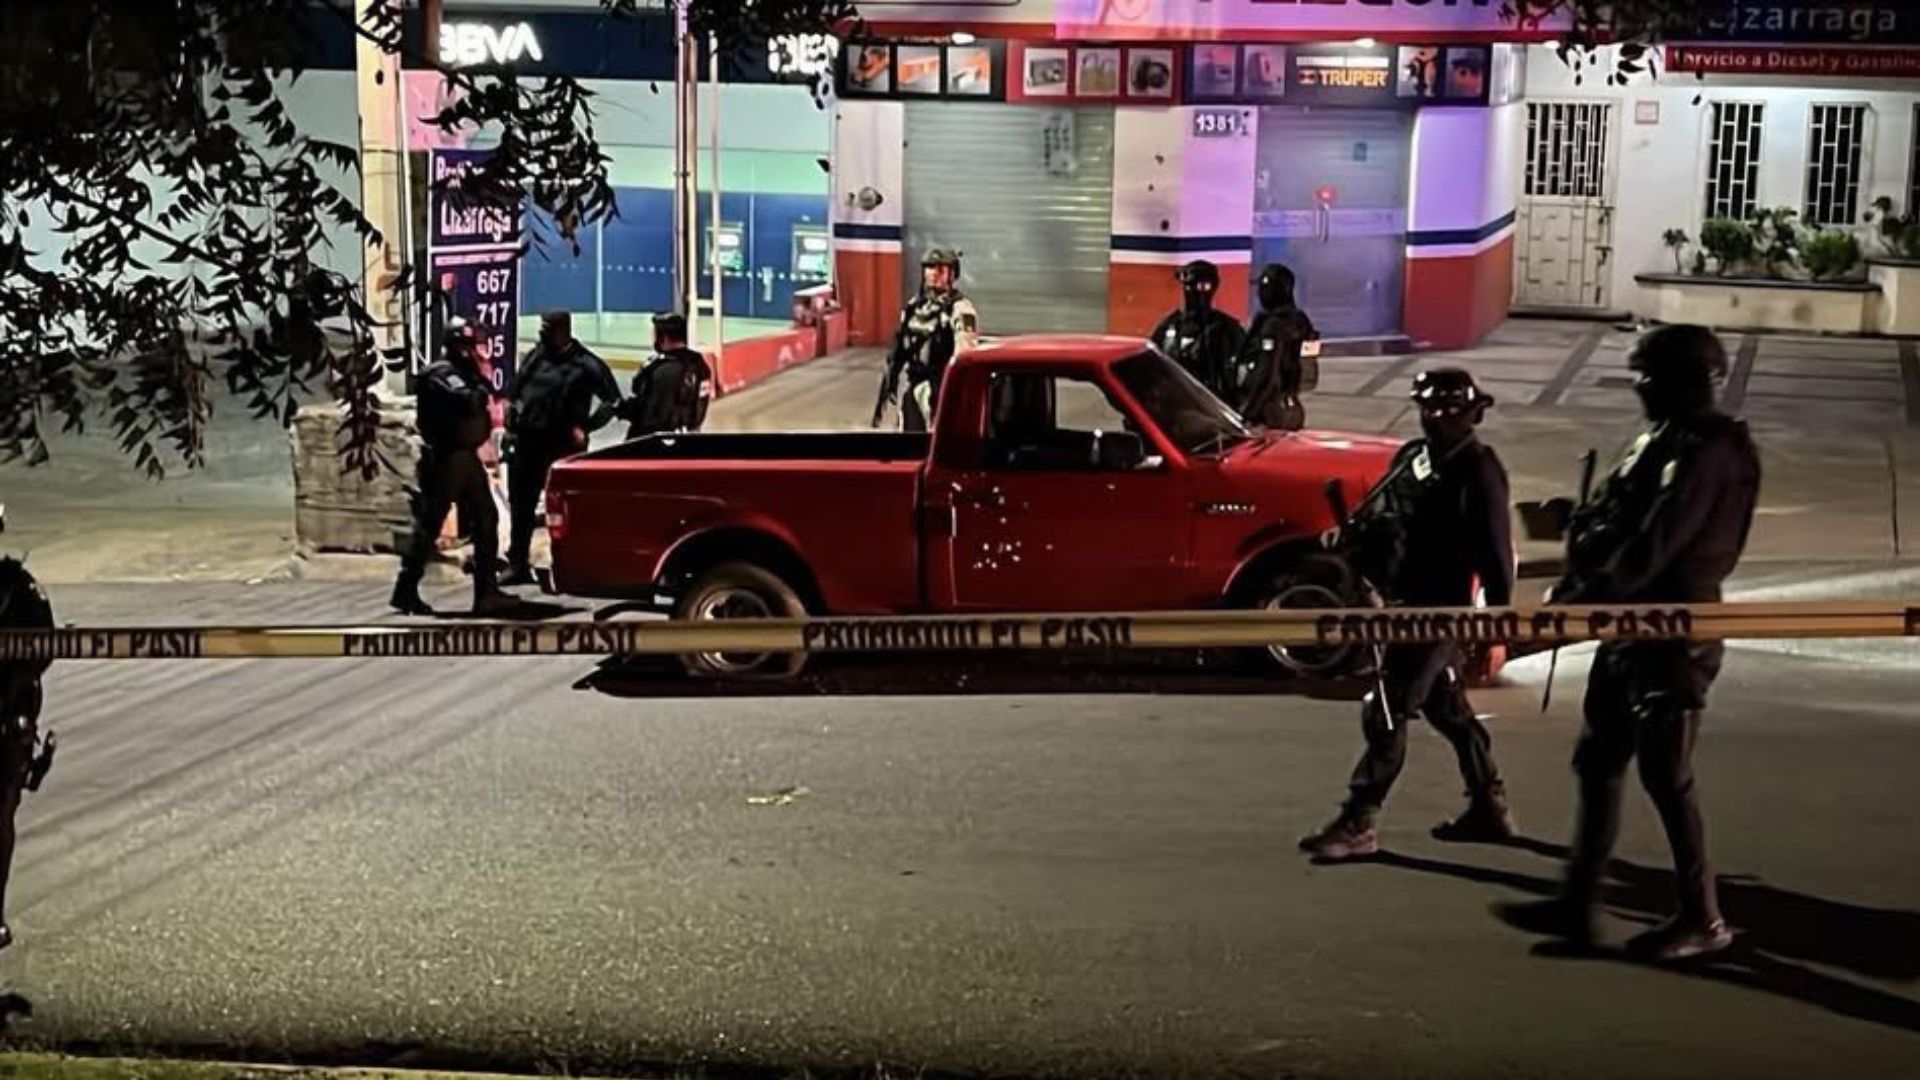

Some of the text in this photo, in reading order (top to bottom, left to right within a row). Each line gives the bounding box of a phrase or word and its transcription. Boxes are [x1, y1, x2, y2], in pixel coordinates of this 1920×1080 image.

[1319, 69, 1388, 87] TRUPER
[1196, 114, 1235, 131] 1381
[477, 269, 510, 295] 667
[477, 302, 510, 326] 717
